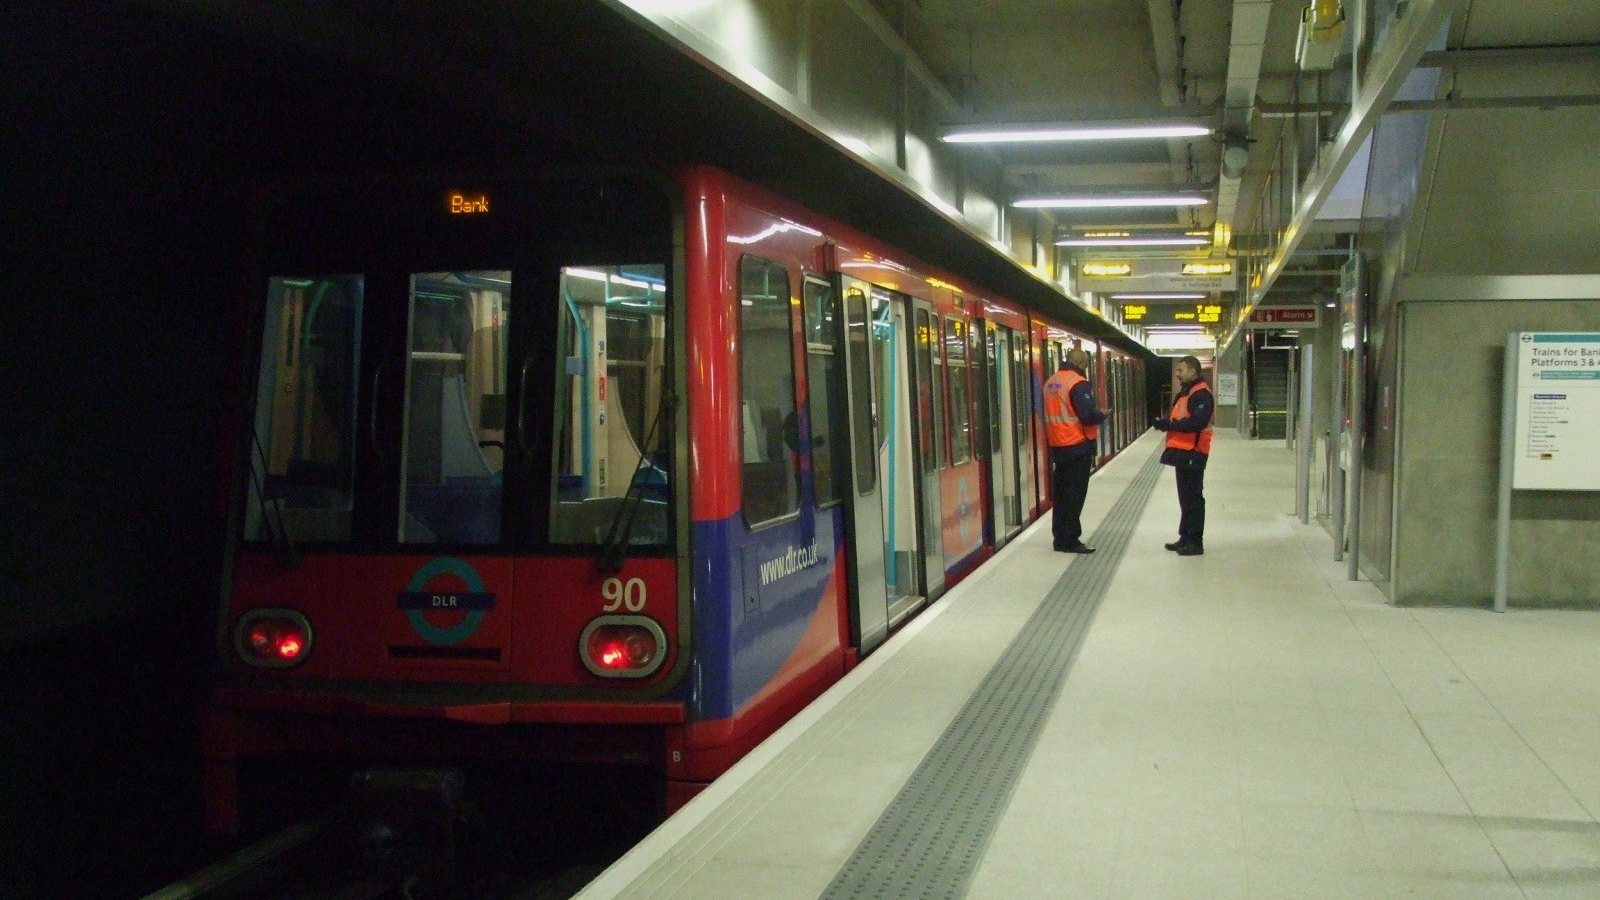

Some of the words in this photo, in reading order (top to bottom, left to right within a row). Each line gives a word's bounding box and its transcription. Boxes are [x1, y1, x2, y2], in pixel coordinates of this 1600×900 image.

[452, 195, 488, 213] Bank
[1282, 311, 1305, 319] Alarm
[1532, 348, 1561, 356] Trains
[1563, 347, 1578, 356] for
[1580, 348, 1600, 356] Ban
[1531, 358, 1578, 366] Platforms
[1580, 358, 1586, 366] 3
[1588, 358, 1595, 366] &
[760, 537, 818, 586] www.dlr.co.uk
[602, 577, 647, 612] 90
[432, 595, 457, 607] DLR
[672, 750, 681, 762] B
